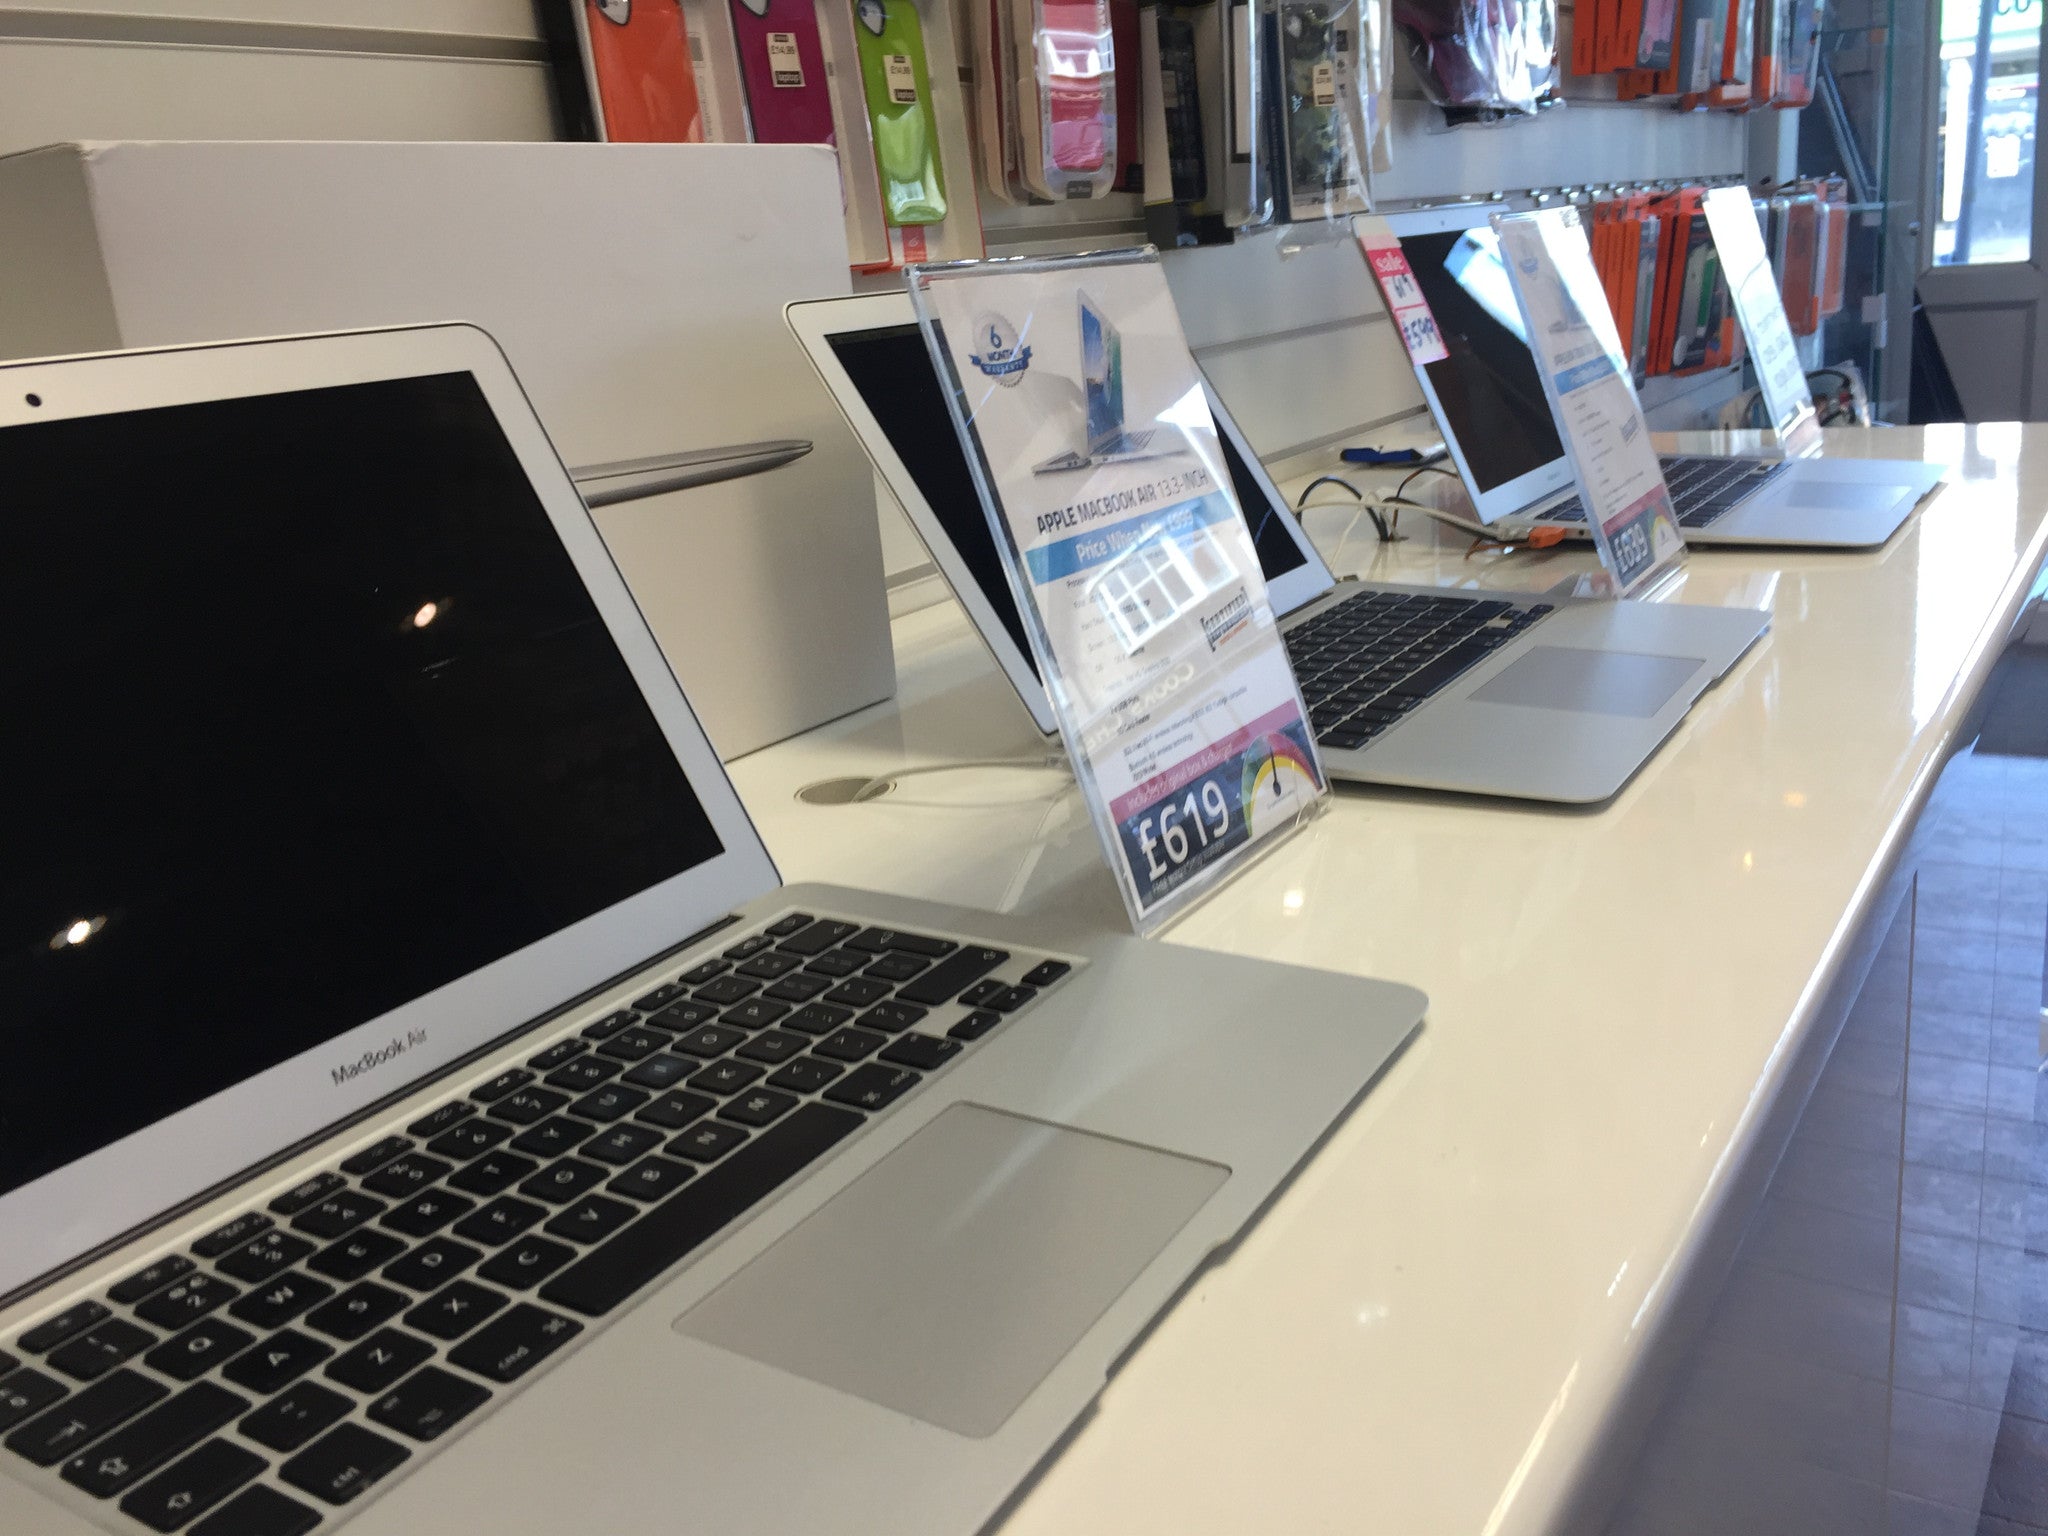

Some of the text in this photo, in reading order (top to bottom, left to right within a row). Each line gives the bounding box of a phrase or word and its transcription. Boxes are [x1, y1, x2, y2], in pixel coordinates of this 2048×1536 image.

[1376, 252, 1405, 272] sale
[990, 324, 1002, 348] 6
[1036, 506, 1078, 535] APPLE
[1076, 491, 1139, 523] MACBOOK
[1137, 483, 1158, 504] AIR
[1075, 540, 1106, 564] Price
[1139, 780, 1230, 881] £619
[331, 1027, 427, 1087] MacBook Air
